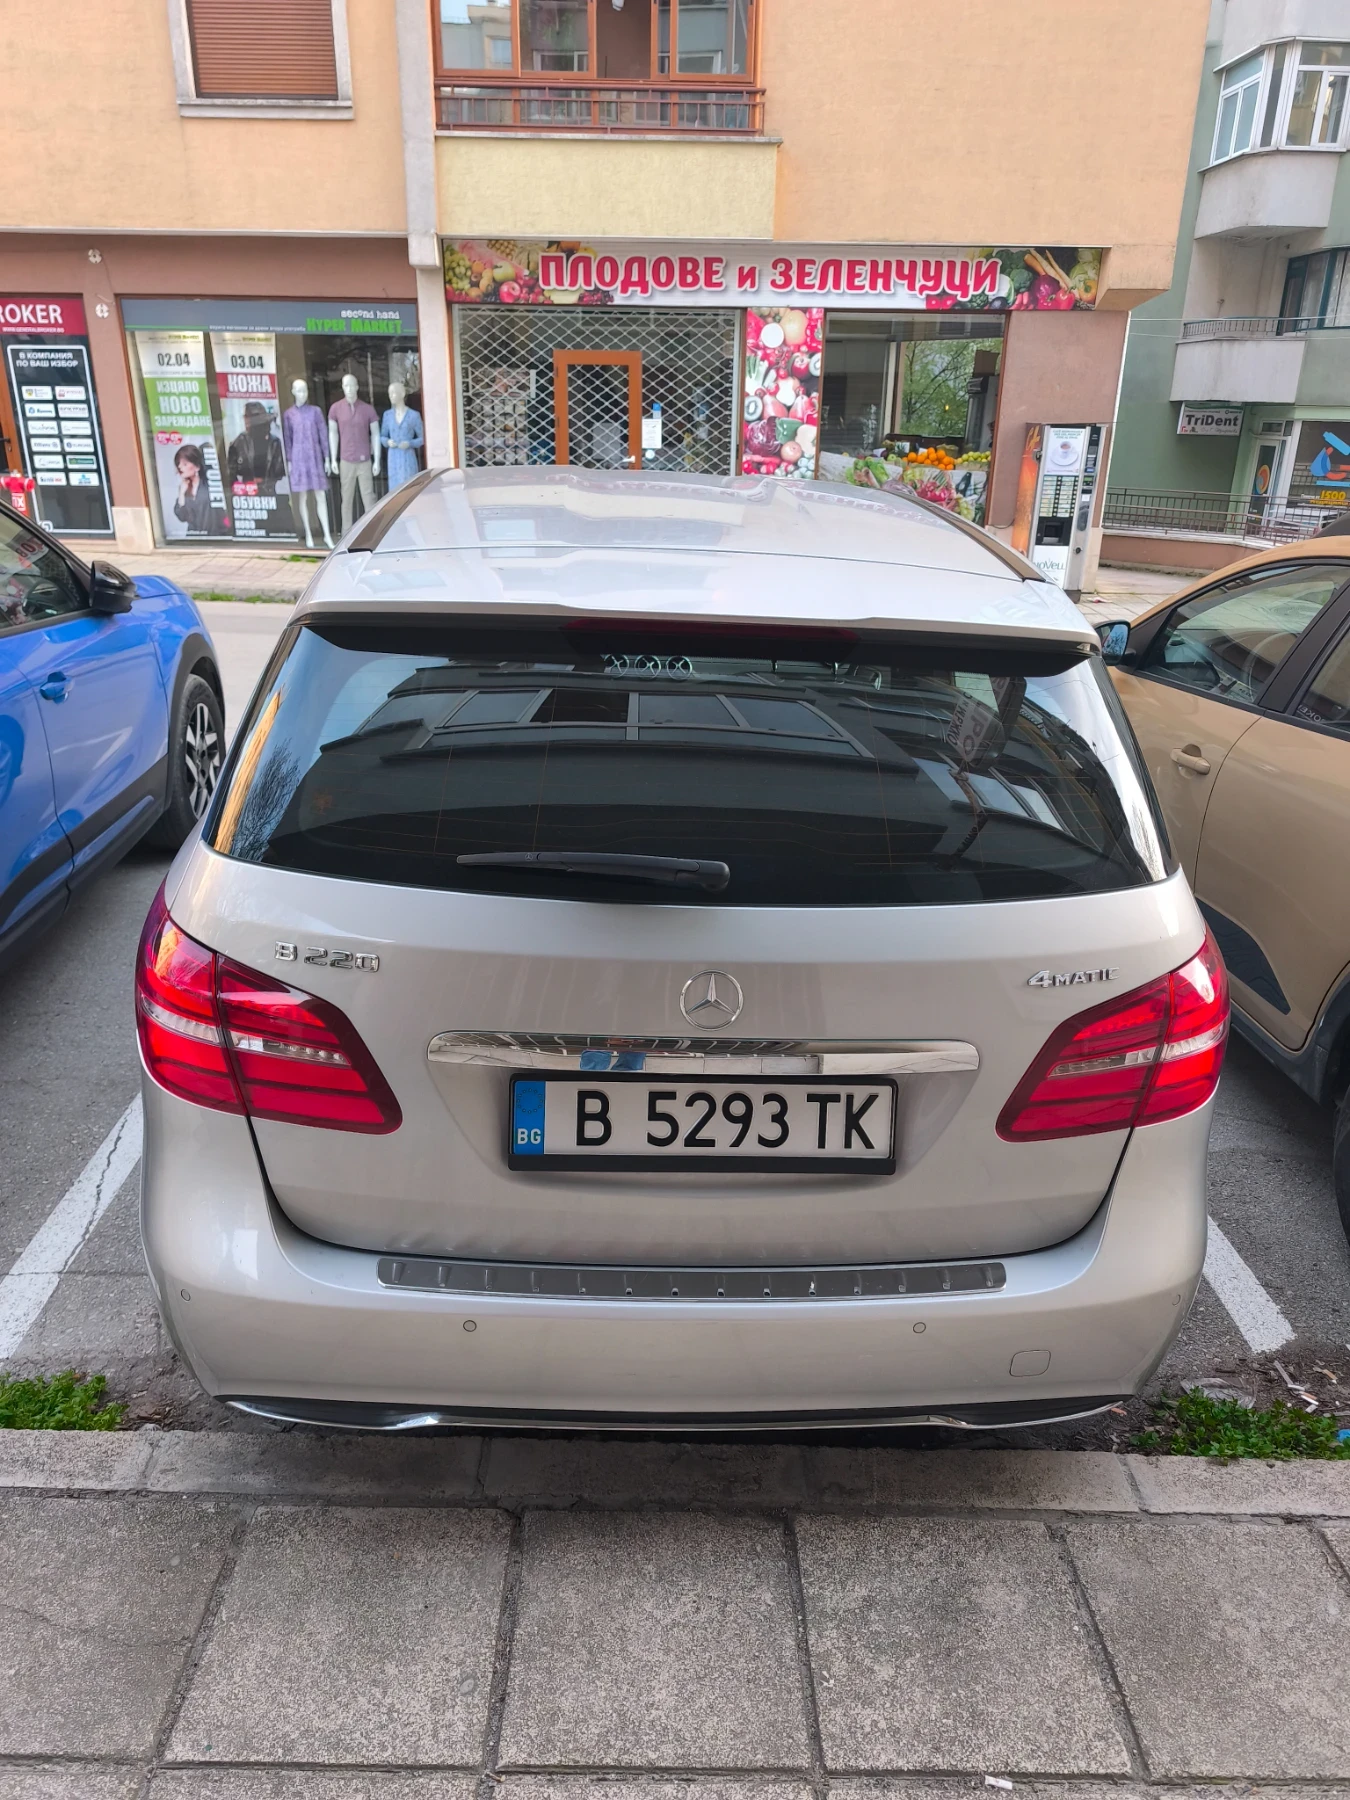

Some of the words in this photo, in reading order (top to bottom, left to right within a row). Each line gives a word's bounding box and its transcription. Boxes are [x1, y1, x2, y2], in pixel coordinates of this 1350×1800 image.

[540, 255, 723, 294] ПЛОДОВЕ
[737, 266, 756, 290] и
[770, 257, 1000, 299] ЗЕЛЕНЧУЦИ
[341, 310, 374, 319] second
[376, 311, 400, 319] hand
[27, 352, 73, 360] КОМПАНИЯ
[157, 353, 190, 367] 02.04
[231, 355, 264, 370] 03.04
[16, 360, 28, 368] ПО
[30, 360, 49, 368] ВАШ
[51, 360, 78, 368] ИЗБОР
[156, 380, 199, 395] ИЗЦЯЛО
[227, 374, 273, 393] КОЖА
[159, 396, 203, 414] НОВО
[155, 415, 212, 429] ЗАРЕЖДАНЕ
[1186, 414, 1240, 427] TriDent
[203, 448, 227, 510] ПРОЛЕТ
[232, 496, 277, 510] ОБУВКИ
[234, 509, 268, 520] ИЗЦЯЛО
[275, 941, 298, 962] B
[304, 946, 380, 973] 220
[1027, 967, 1120, 988] 4MATIC
[576, 1090, 612, 1147] B
[646, 1090, 789, 1149] 5293
[806, 1093, 880, 1150] TK
[517, 1128, 542, 1145] BG
